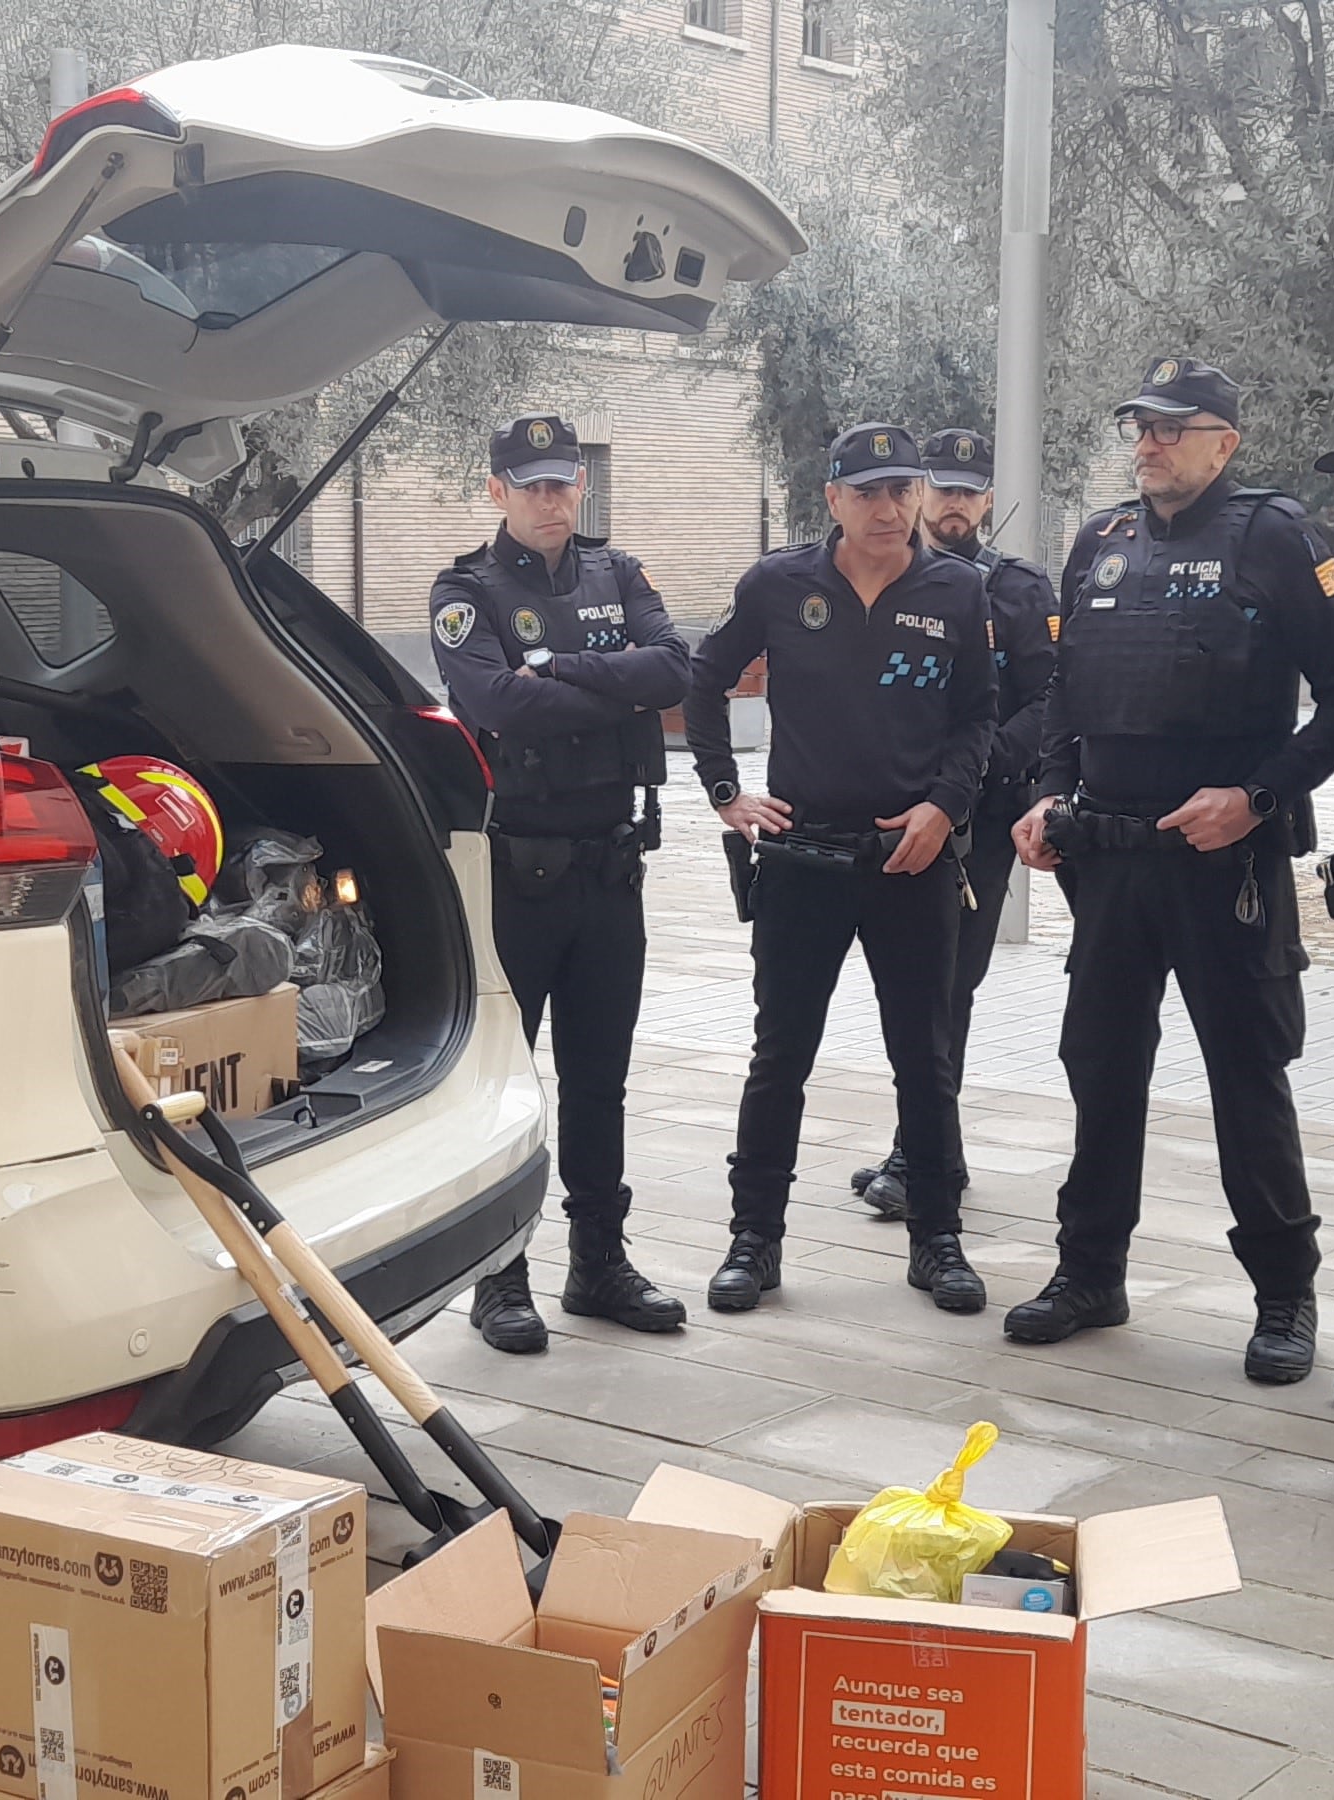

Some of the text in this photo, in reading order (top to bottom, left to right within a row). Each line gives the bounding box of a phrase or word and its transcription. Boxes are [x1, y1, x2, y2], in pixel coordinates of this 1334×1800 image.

[895, 613, 945, 631] POLICIA
[926, 629, 946, 639] LOCAL
[833, 1676, 964, 1703] Aunque sea
[838, 1705, 940, 1732] tentador,
[832, 1734, 979, 1763] recuerda que
[831, 1763, 997, 1791] esta comida es
